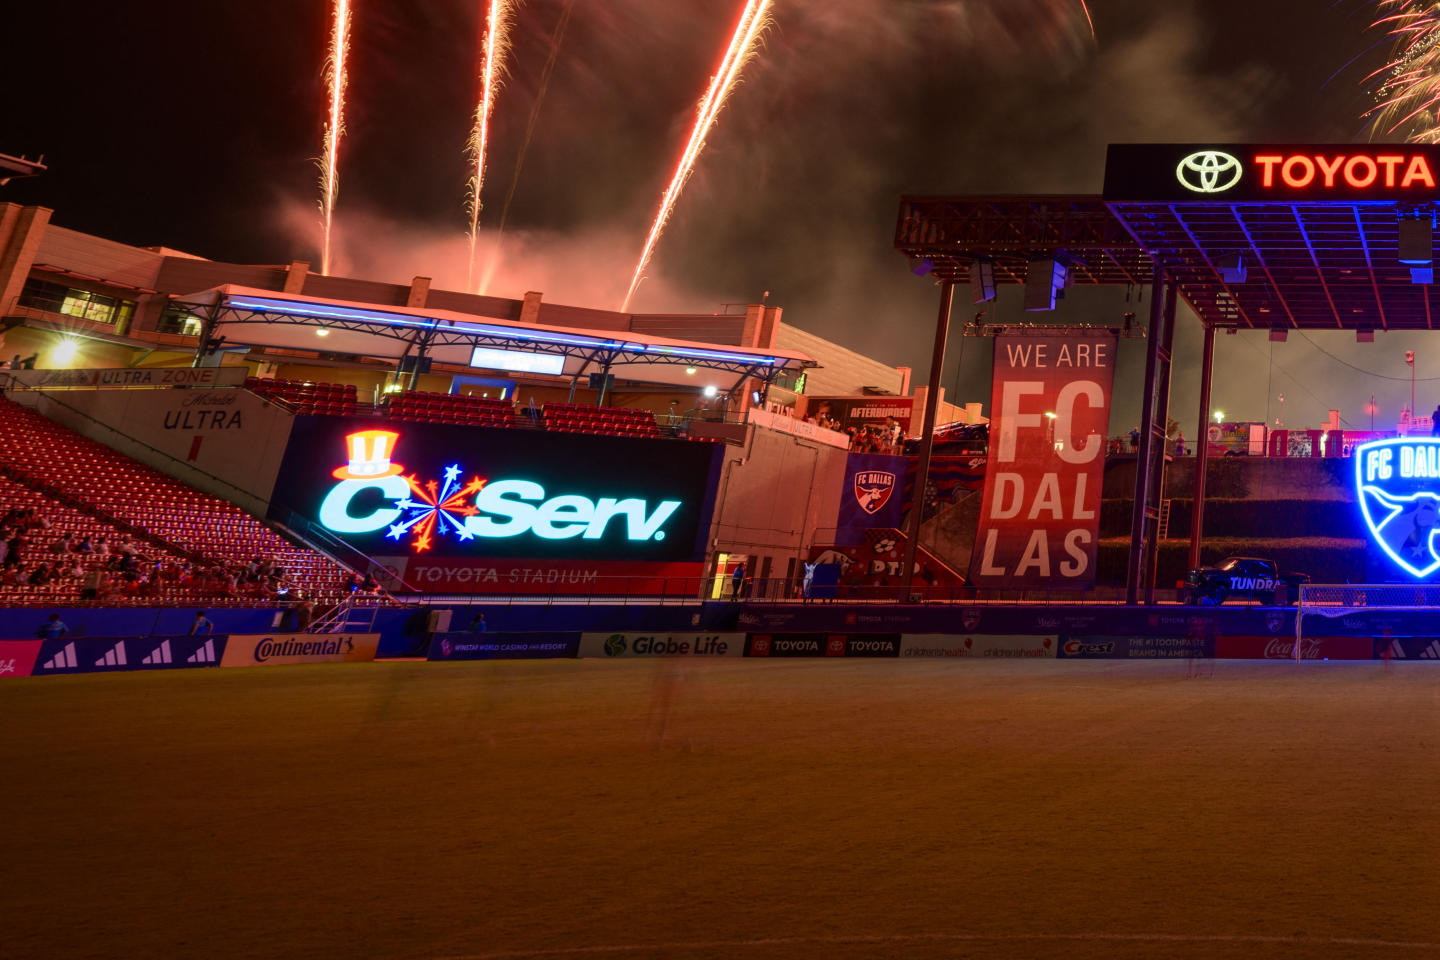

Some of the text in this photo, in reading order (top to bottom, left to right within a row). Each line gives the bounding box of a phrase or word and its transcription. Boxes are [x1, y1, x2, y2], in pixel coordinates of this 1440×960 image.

[1255, 155, 1436, 188] TOYOTA
[1007, 344, 1107, 368] WE ARE
[102, 370, 153, 385] ULTRA
[161, 369, 214, 383] ZONE
[163, 410, 242, 429] ULTRA
[997, 380, 1105, 464] FC
[1367, 448, 1392, 482] FC
[857, 473, 892, 486] FC DALLAS
[990, 472, 1096, 520] DAL
[980, 528, 1092, 577] LAS
[414, 566, 598, 585] TOYOTA STADIUM
[1230, 576, 1281, 591] TUNDRA
[254, 637, 343, 662] Continental
[632, 635, 728, 655] Globe Life
[774, 640, 819, 651] TOYOTA
[849, 640, 894, 651] TOYOTA
[1064, 640, 1115, 656] Crest
